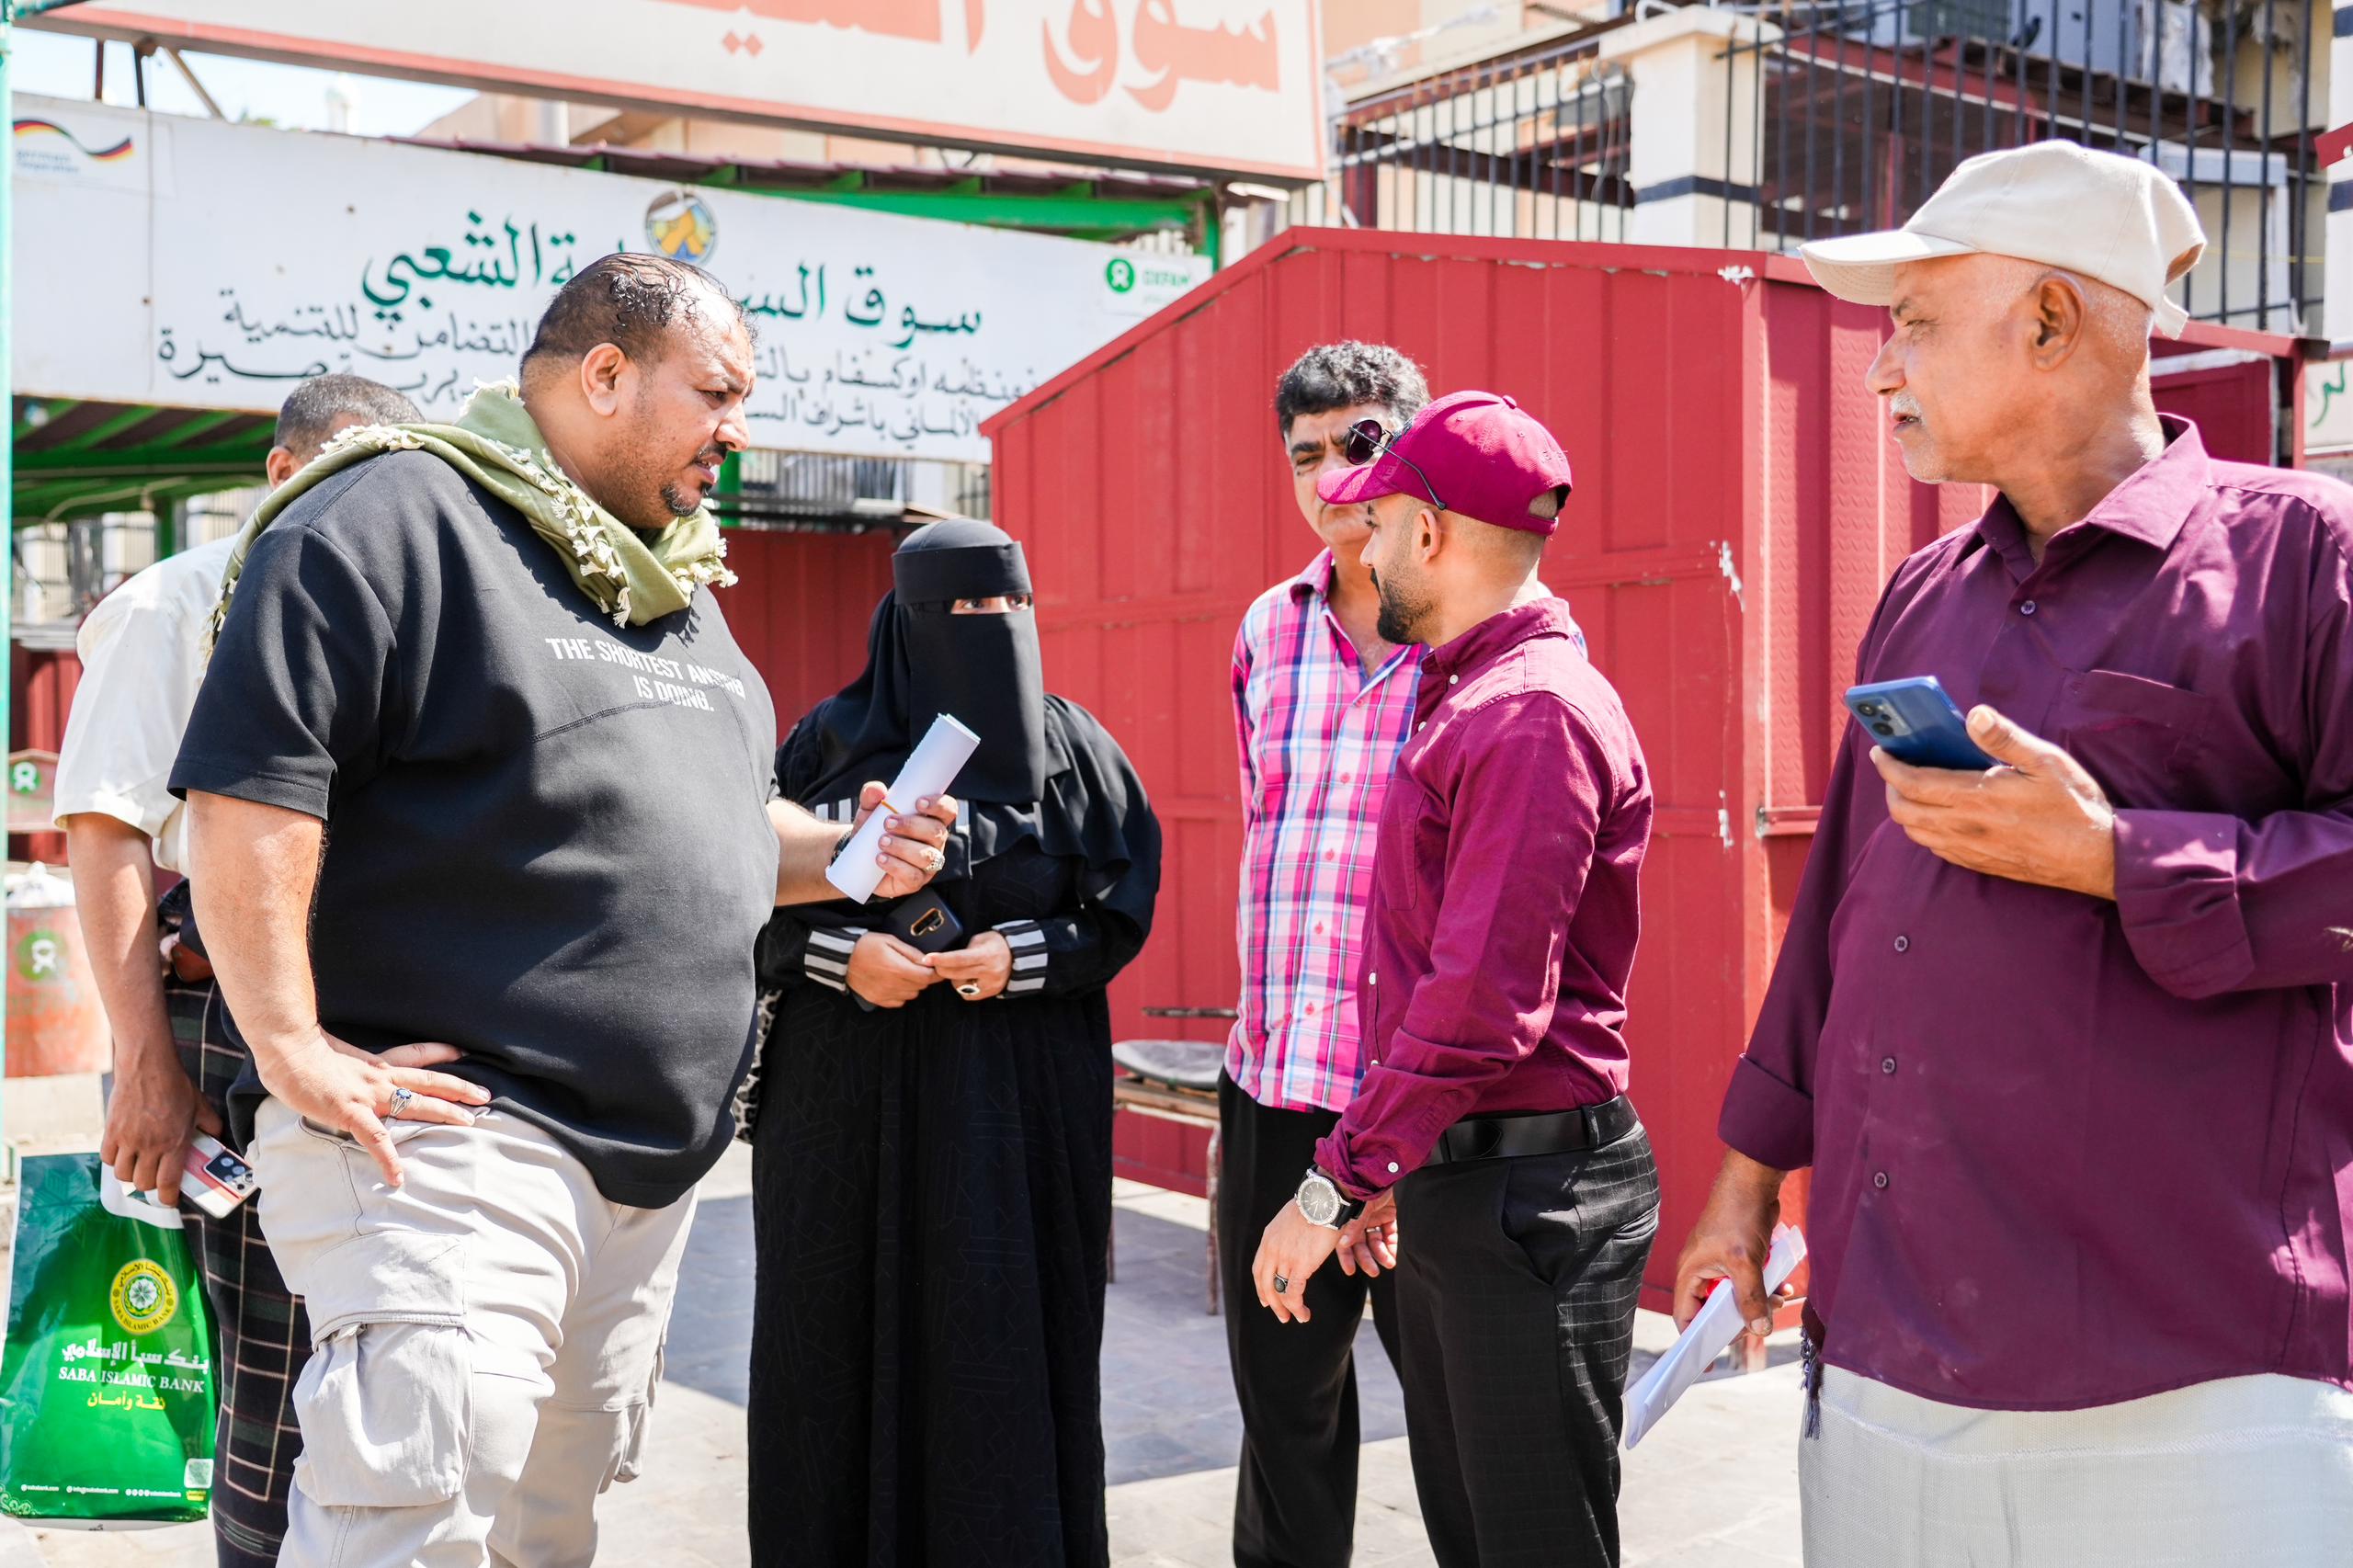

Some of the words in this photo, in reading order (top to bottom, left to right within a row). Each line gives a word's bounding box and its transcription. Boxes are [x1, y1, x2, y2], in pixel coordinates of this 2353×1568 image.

[362, 210, 541, 322] الشعبي
[844, 265, 982, 348] سوق
[159, 328, 329, 383] صيرة
[545, 638, 596, 660] THE
[594, 641, 684, 680] SHORTEST
[632, 675, 654, 699] IS
[653, 680, 715, 712] DOING.
[62, 1337, 129, 1368] الإسلامي
[131, 1338, 164, 1369] سبأ
[164, 1347, 210, 1376] بنك
[58, 1366, 97, 1383] SABA
[101, 1369, 156, 1389] ISLAMIC
[159, 1376, 205, 1393] BANK
